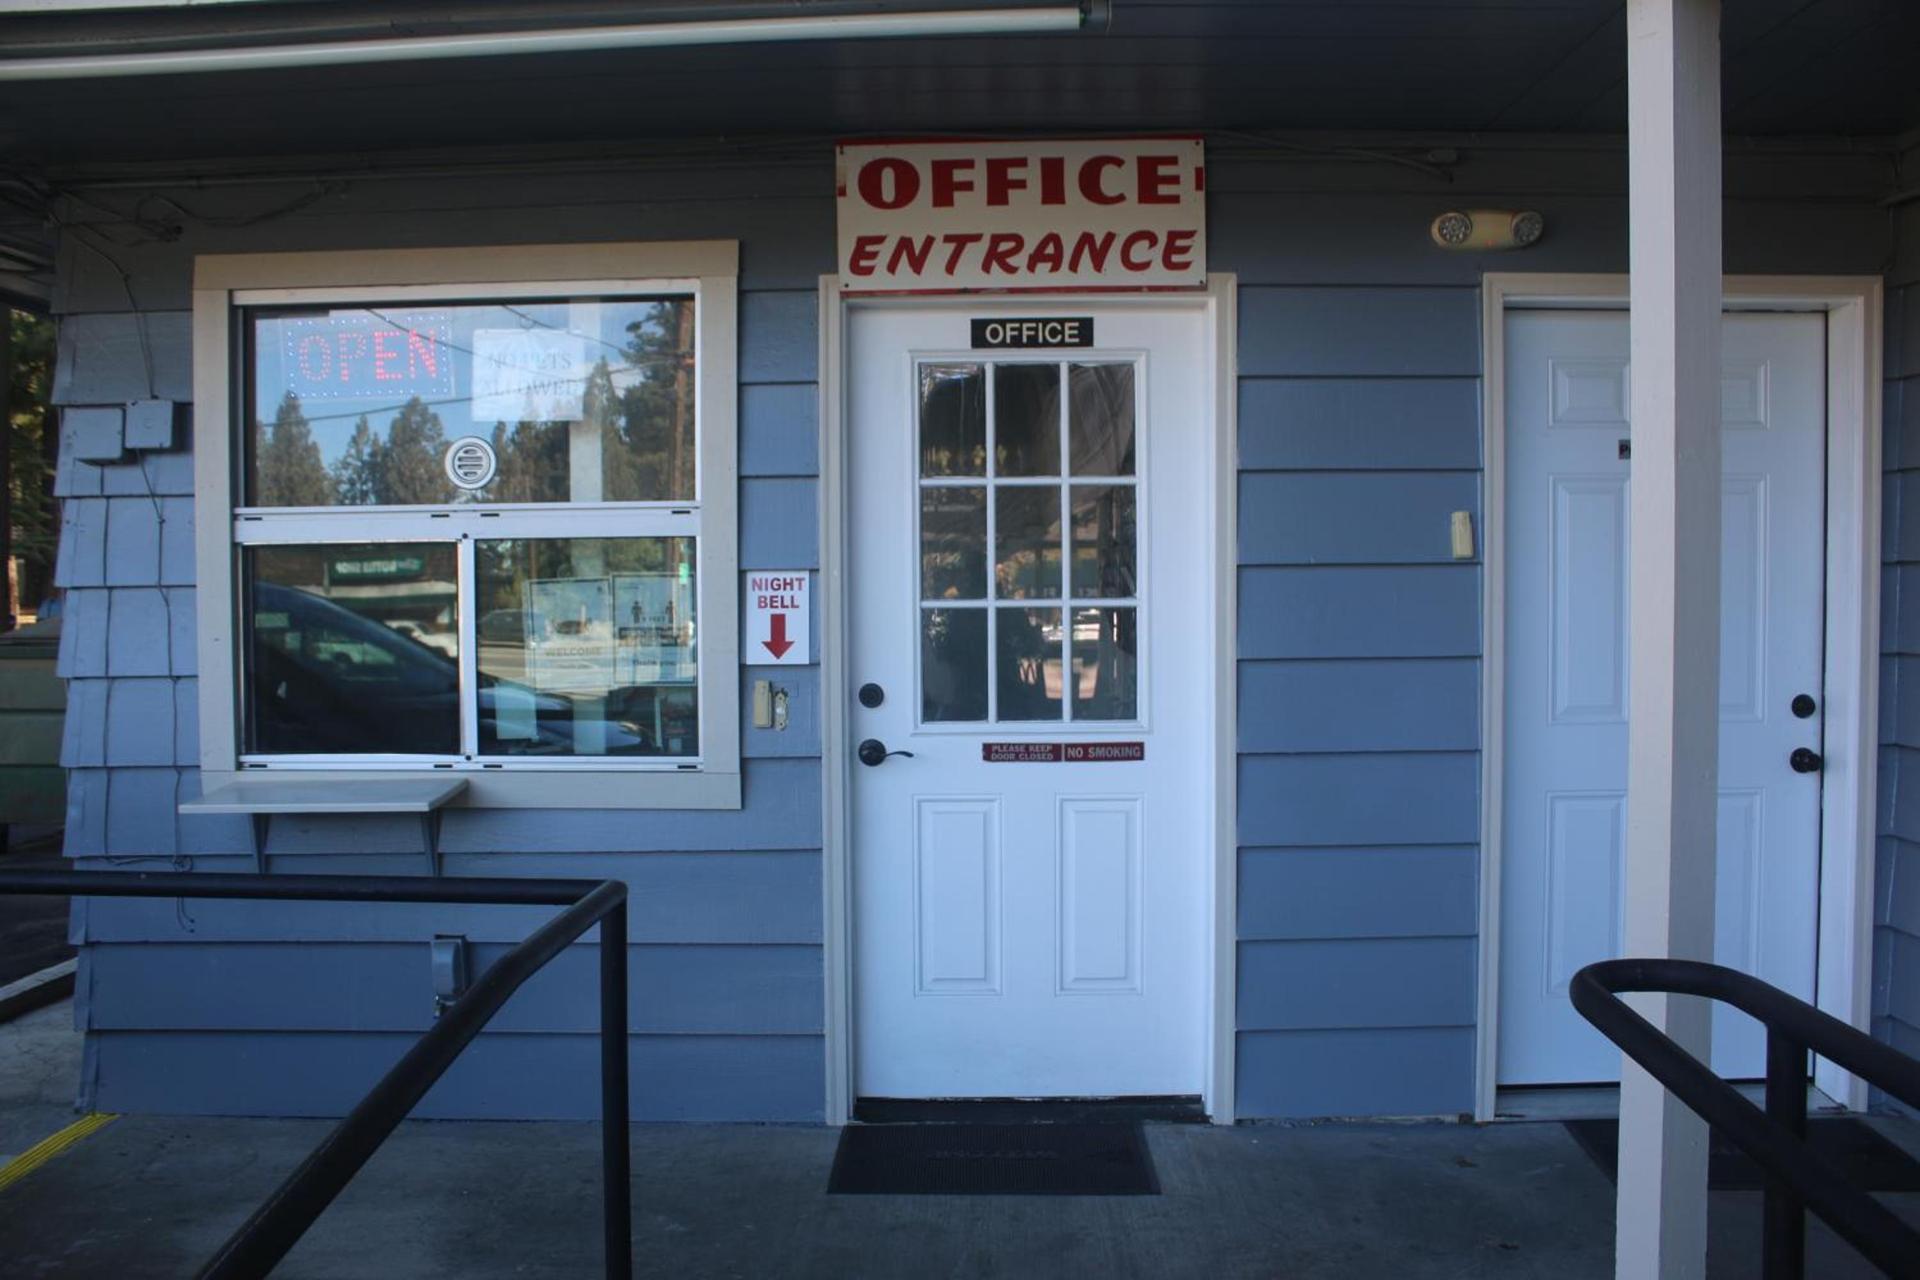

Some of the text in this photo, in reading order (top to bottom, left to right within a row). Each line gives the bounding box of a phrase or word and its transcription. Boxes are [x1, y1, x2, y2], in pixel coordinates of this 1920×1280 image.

[858, 155, 1181, 209] OFFICE
[850, 230, 1198, 276] ENTRANCE
[985, 321, 1080, 344] OFFICE
[300, 328, 437, 382] OPEN
[752, 577, 805, 591] NIGHT
[757, 595, 800, 609] BELL
[1028, 744, 1053, 752] KEEP
[1067, 746, 1140, 758] NO SMOKING
